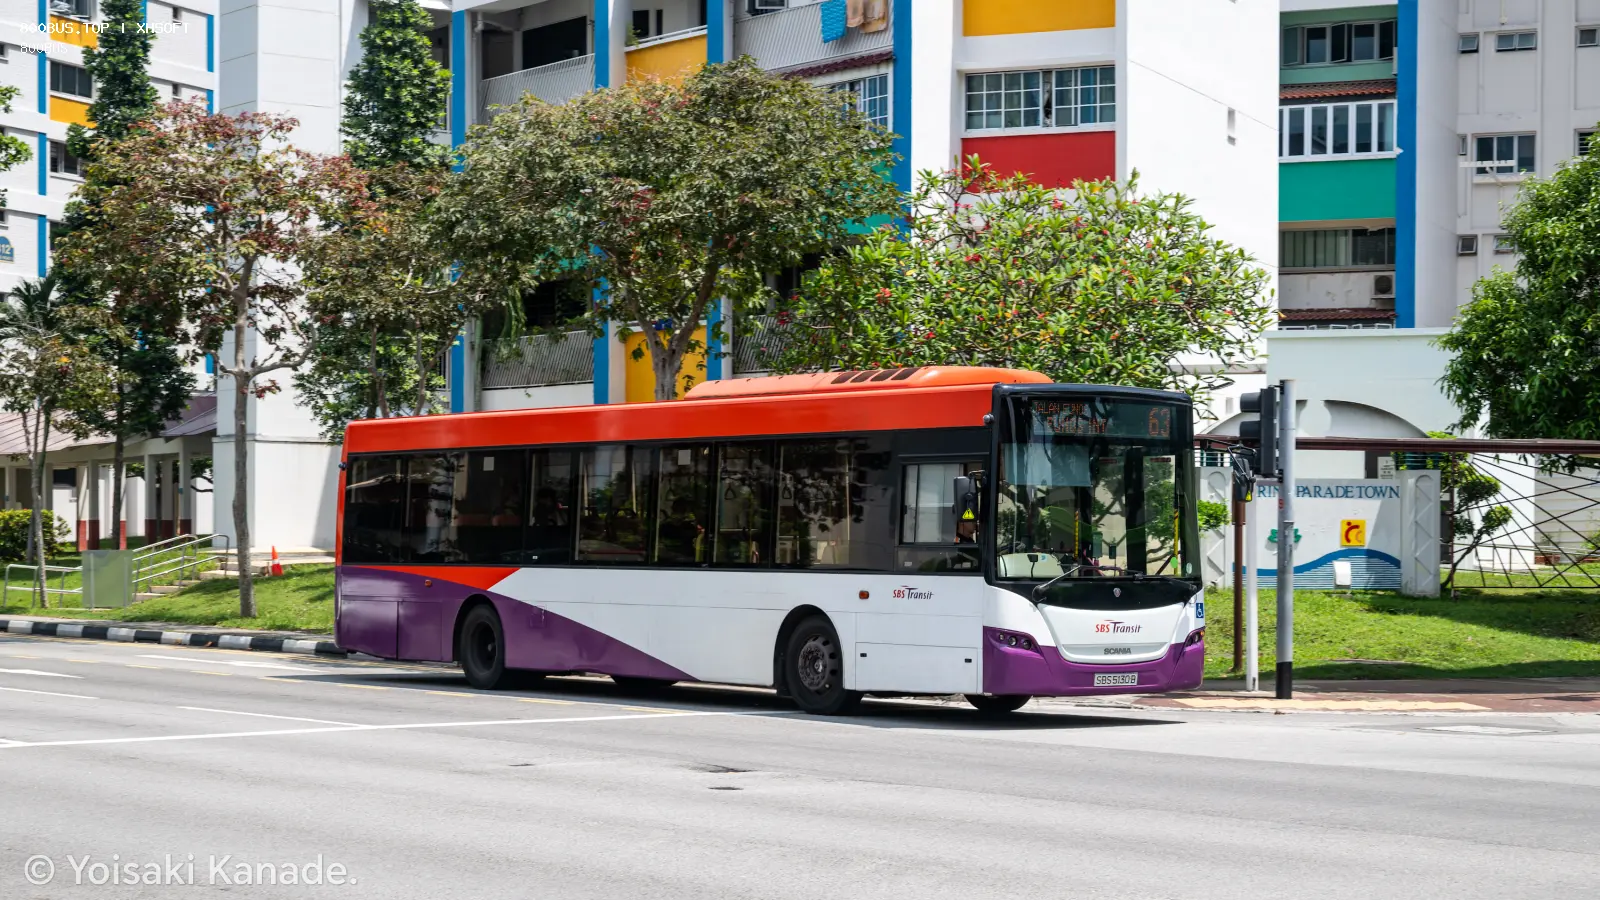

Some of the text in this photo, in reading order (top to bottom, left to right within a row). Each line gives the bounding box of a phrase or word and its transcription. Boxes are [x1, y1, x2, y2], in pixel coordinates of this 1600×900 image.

[1149, 407, 1170, 437] 63
[1296, 485, 1354, 498] PARADE
[1356, 485, 1400, 498] TOWN
[893, 587, 934, 600] SBS Transit
[1095, 621, 1143, 634] SBS Transit
[1104, 647, 1131, 655] SCANIA
